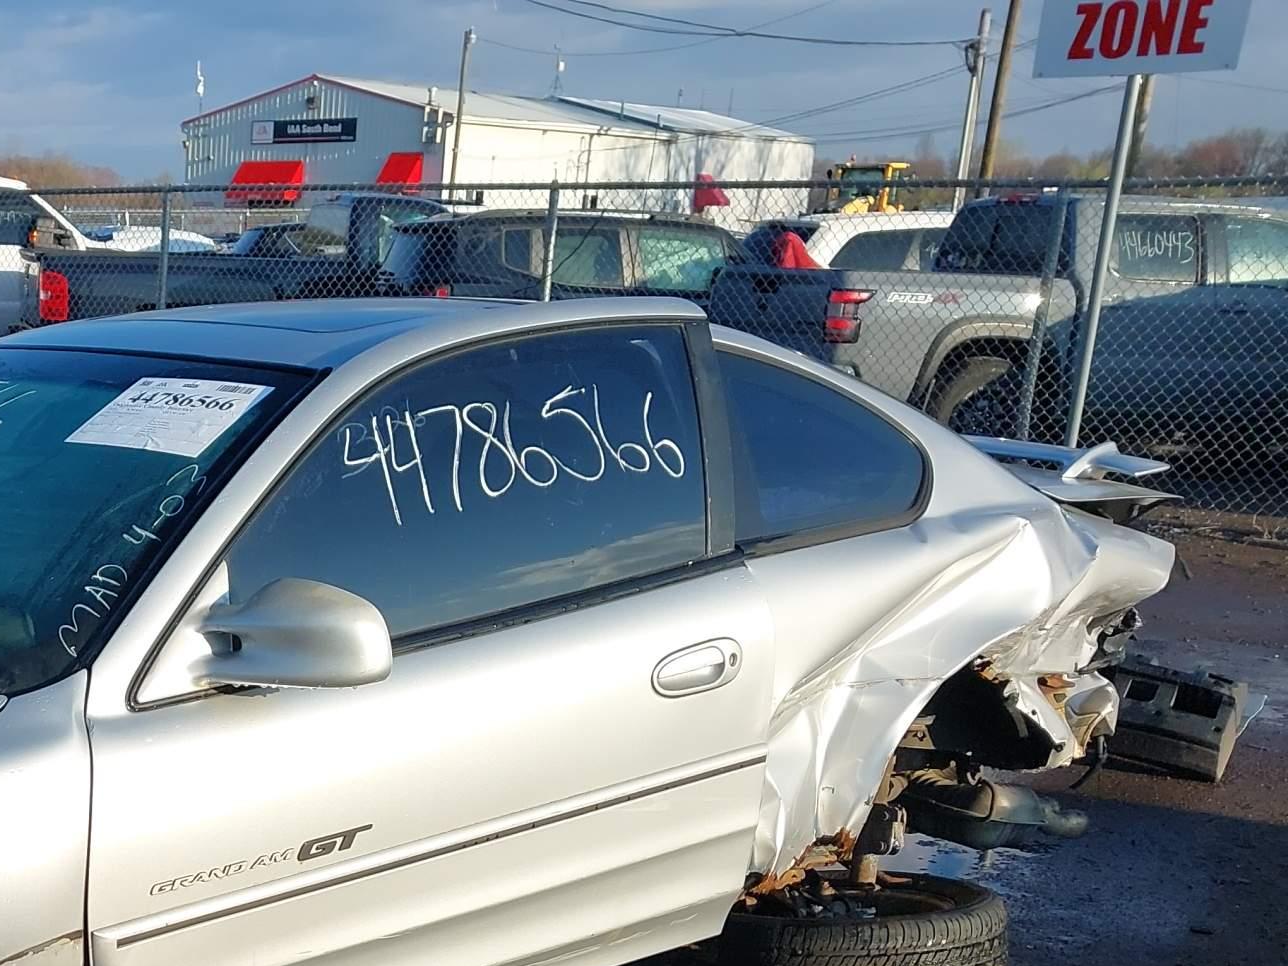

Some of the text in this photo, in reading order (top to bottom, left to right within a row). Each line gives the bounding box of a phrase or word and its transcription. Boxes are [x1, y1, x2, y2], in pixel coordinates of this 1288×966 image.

[1067, 0, 1213, 60] ZONE
[1119, 231, 1195, 264] 44660443
[127, 391, 241, 412] 44786566
[343, 383, 686, 526] 44786566
[58, 564, 128, 658] MAD
[122, 464, 207, 545] 4-03
[149, 823, 374, 896] GRAND AM GT
